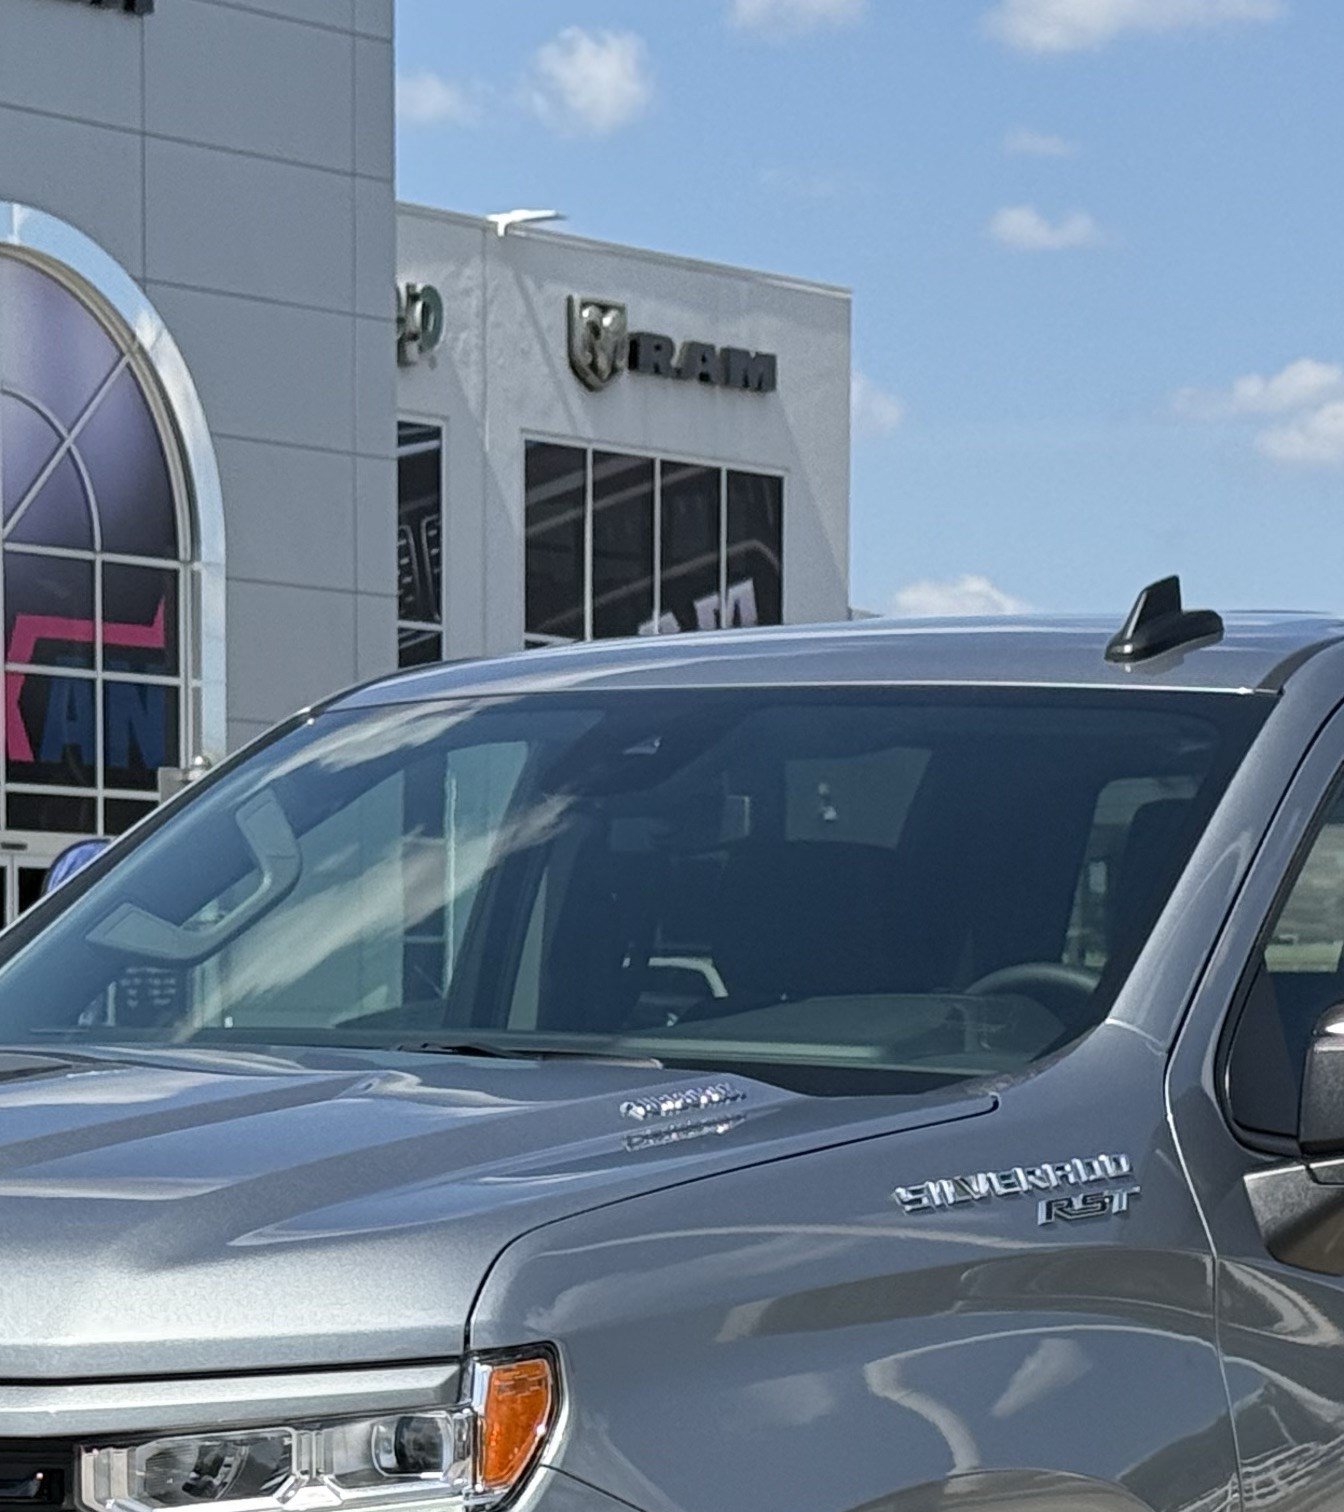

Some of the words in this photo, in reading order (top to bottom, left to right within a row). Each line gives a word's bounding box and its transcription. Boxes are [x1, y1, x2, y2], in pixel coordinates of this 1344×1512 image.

[627, 331, 778, 393] RAM
[893, 1153, 1133, 1213] SILVERADO
[1037, 1185, 1142, 1227] RST
